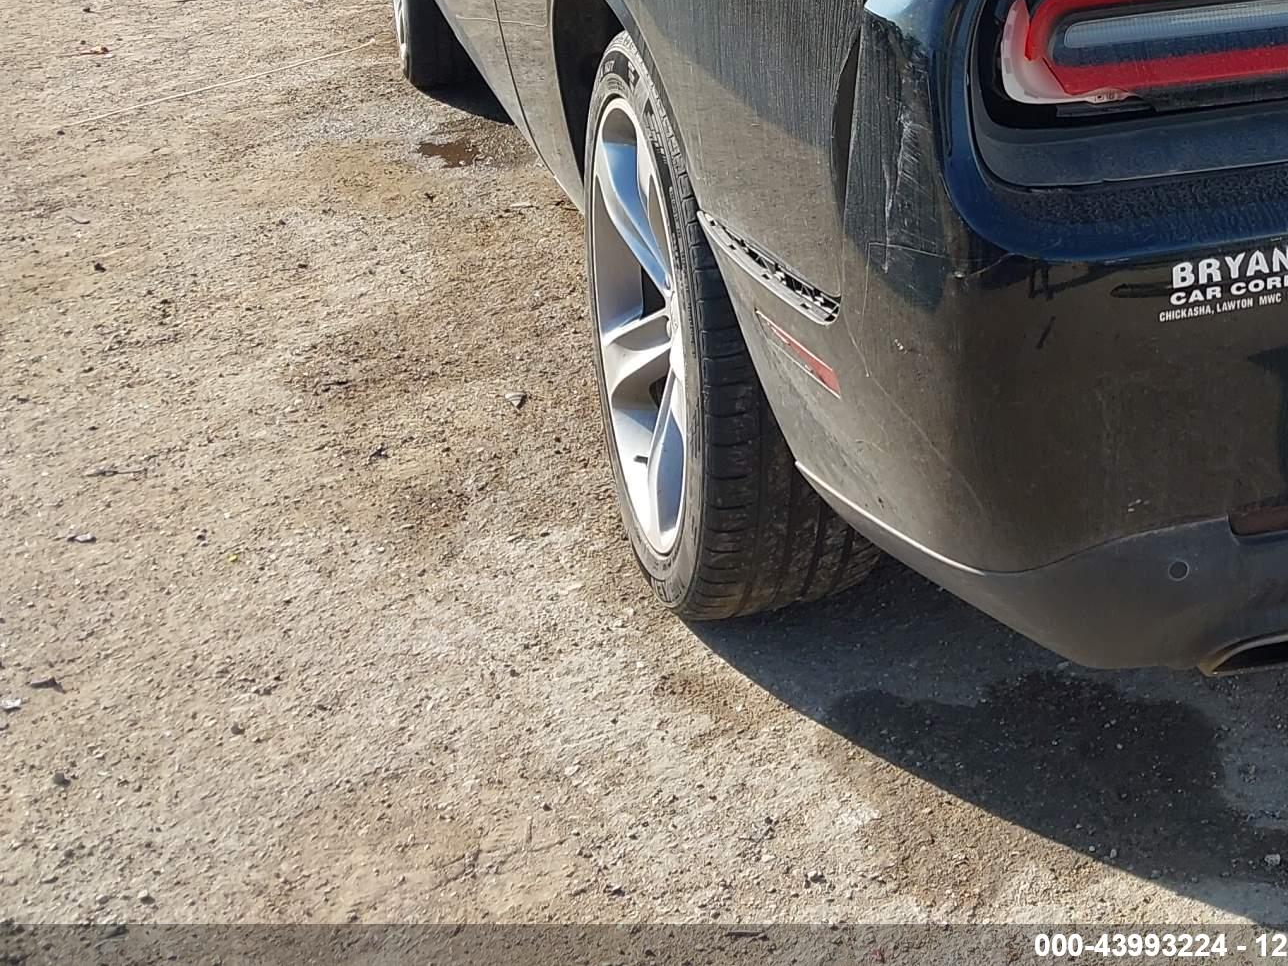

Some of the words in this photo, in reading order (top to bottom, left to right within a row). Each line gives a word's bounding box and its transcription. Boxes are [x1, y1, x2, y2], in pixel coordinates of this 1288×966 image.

[1159, 304, 1215, 322] CHICKASHA,
[1216, 297, 1254, 313] LAWTON
[1259, 292, 1282, 306] MWC
[1170, 286, 1222, 306] CAR
